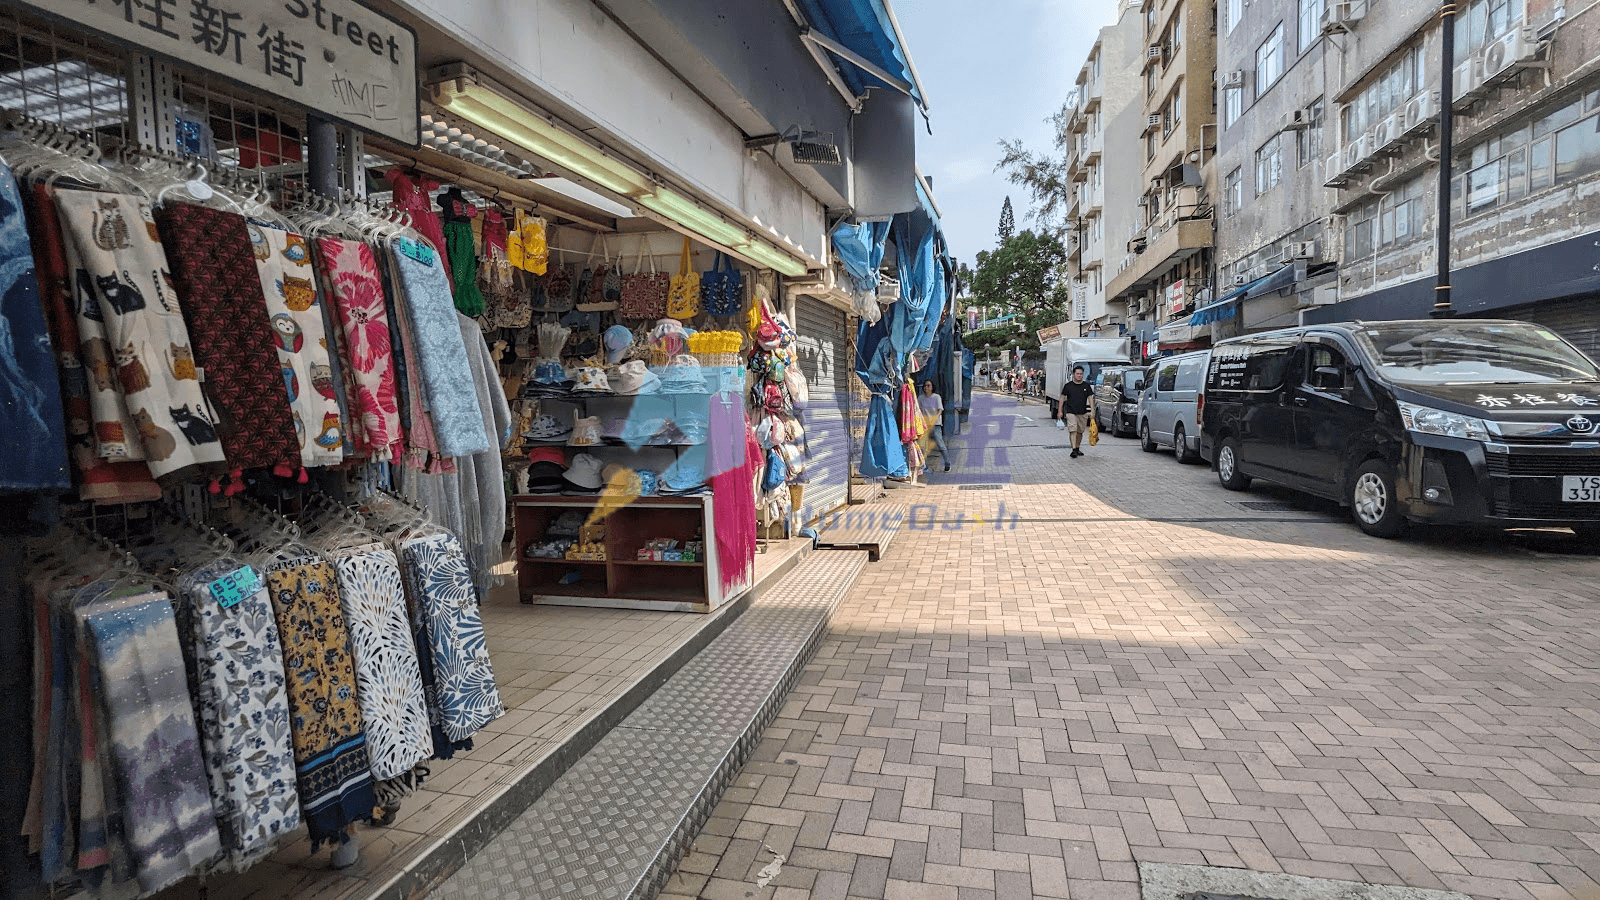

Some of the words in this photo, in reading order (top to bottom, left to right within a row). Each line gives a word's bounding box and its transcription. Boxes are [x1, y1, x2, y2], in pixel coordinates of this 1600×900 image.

[285, 0, 399, 65] Street
[89, 0, 307, 87] 柱新街
[1475, 392, 1600, 407] 赤柱餐
[1579, 477, 1600, 489] YS
[1568, 488, 1600, 501] 331
